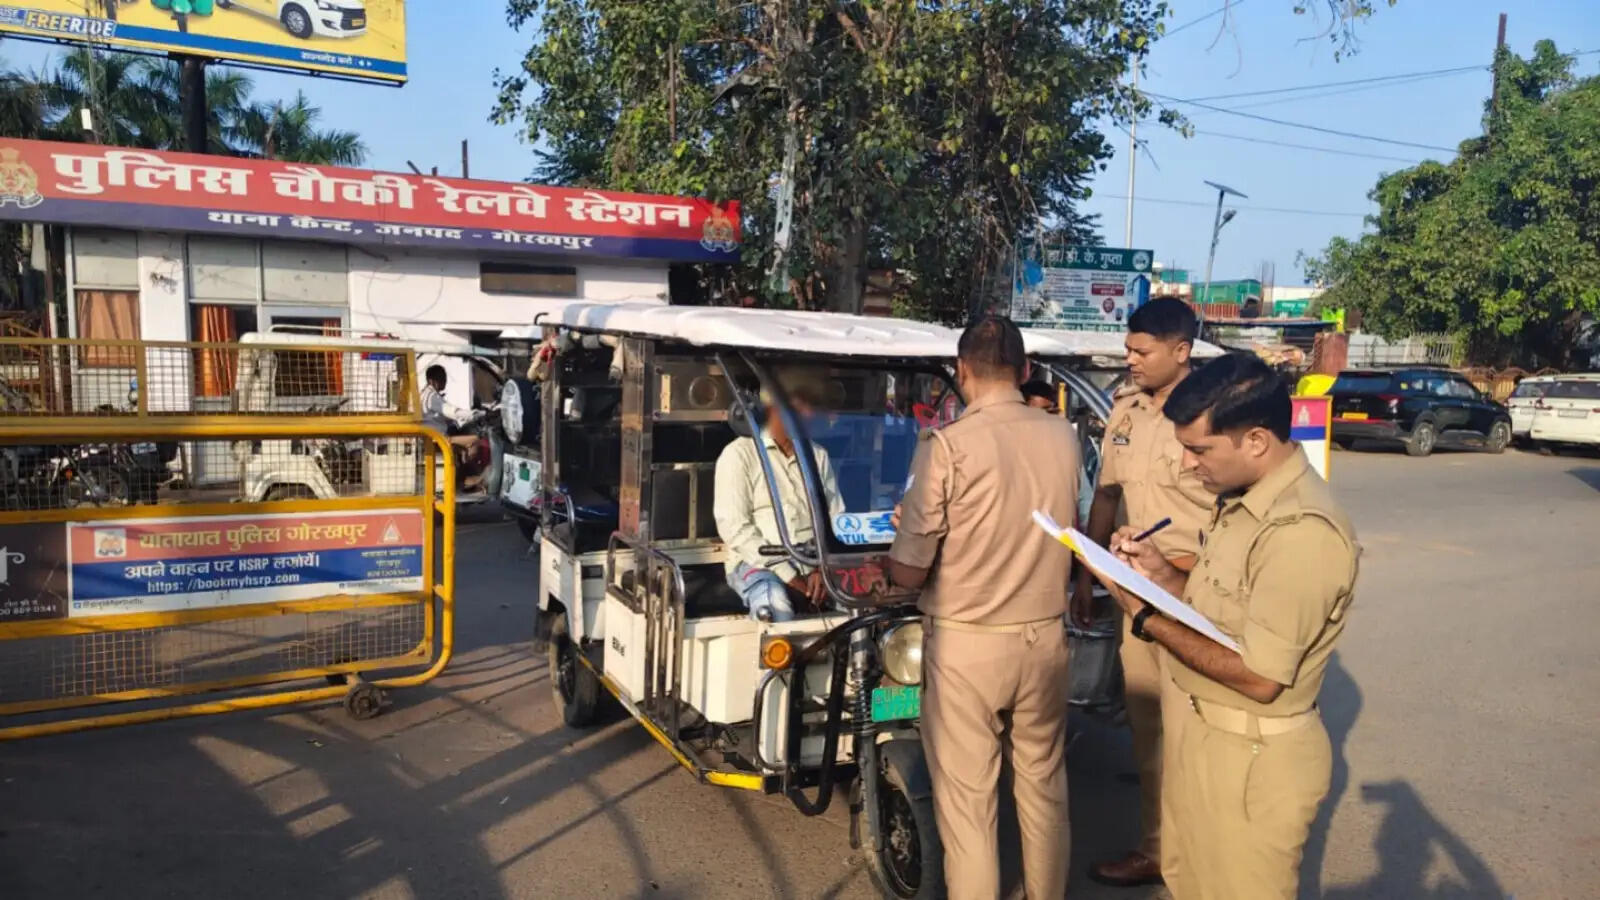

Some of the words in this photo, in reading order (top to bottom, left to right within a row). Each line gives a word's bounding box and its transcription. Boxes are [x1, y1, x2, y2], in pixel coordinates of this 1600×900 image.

[26, 11, 116, 37] FREERIDE
[51, 151, 253, 195] पुलिस
[271, 166, 418, 209] चौकी
[424, 178, 551, 219] रेलवे
[565, 192, 694, 228] स्टेशन
[208, 212, 281, 228] थाना
[374, 223, 464, 240] जनपद
[492, 230, 593, 249] गोरखपुर
[1100, 252, 1123, 270] गुप्ता
[139, 530, 221, 549] यातायात
[226, 523, 281, 551] पुलिस
[285, 522, 368, 545] गोरखपुर
[124, 561, 165, 579] अपने
[169, 561, 210, 577] वाहन
[213, 559, 235, 573] पर
[238, 556, 269, 573] HSRP
